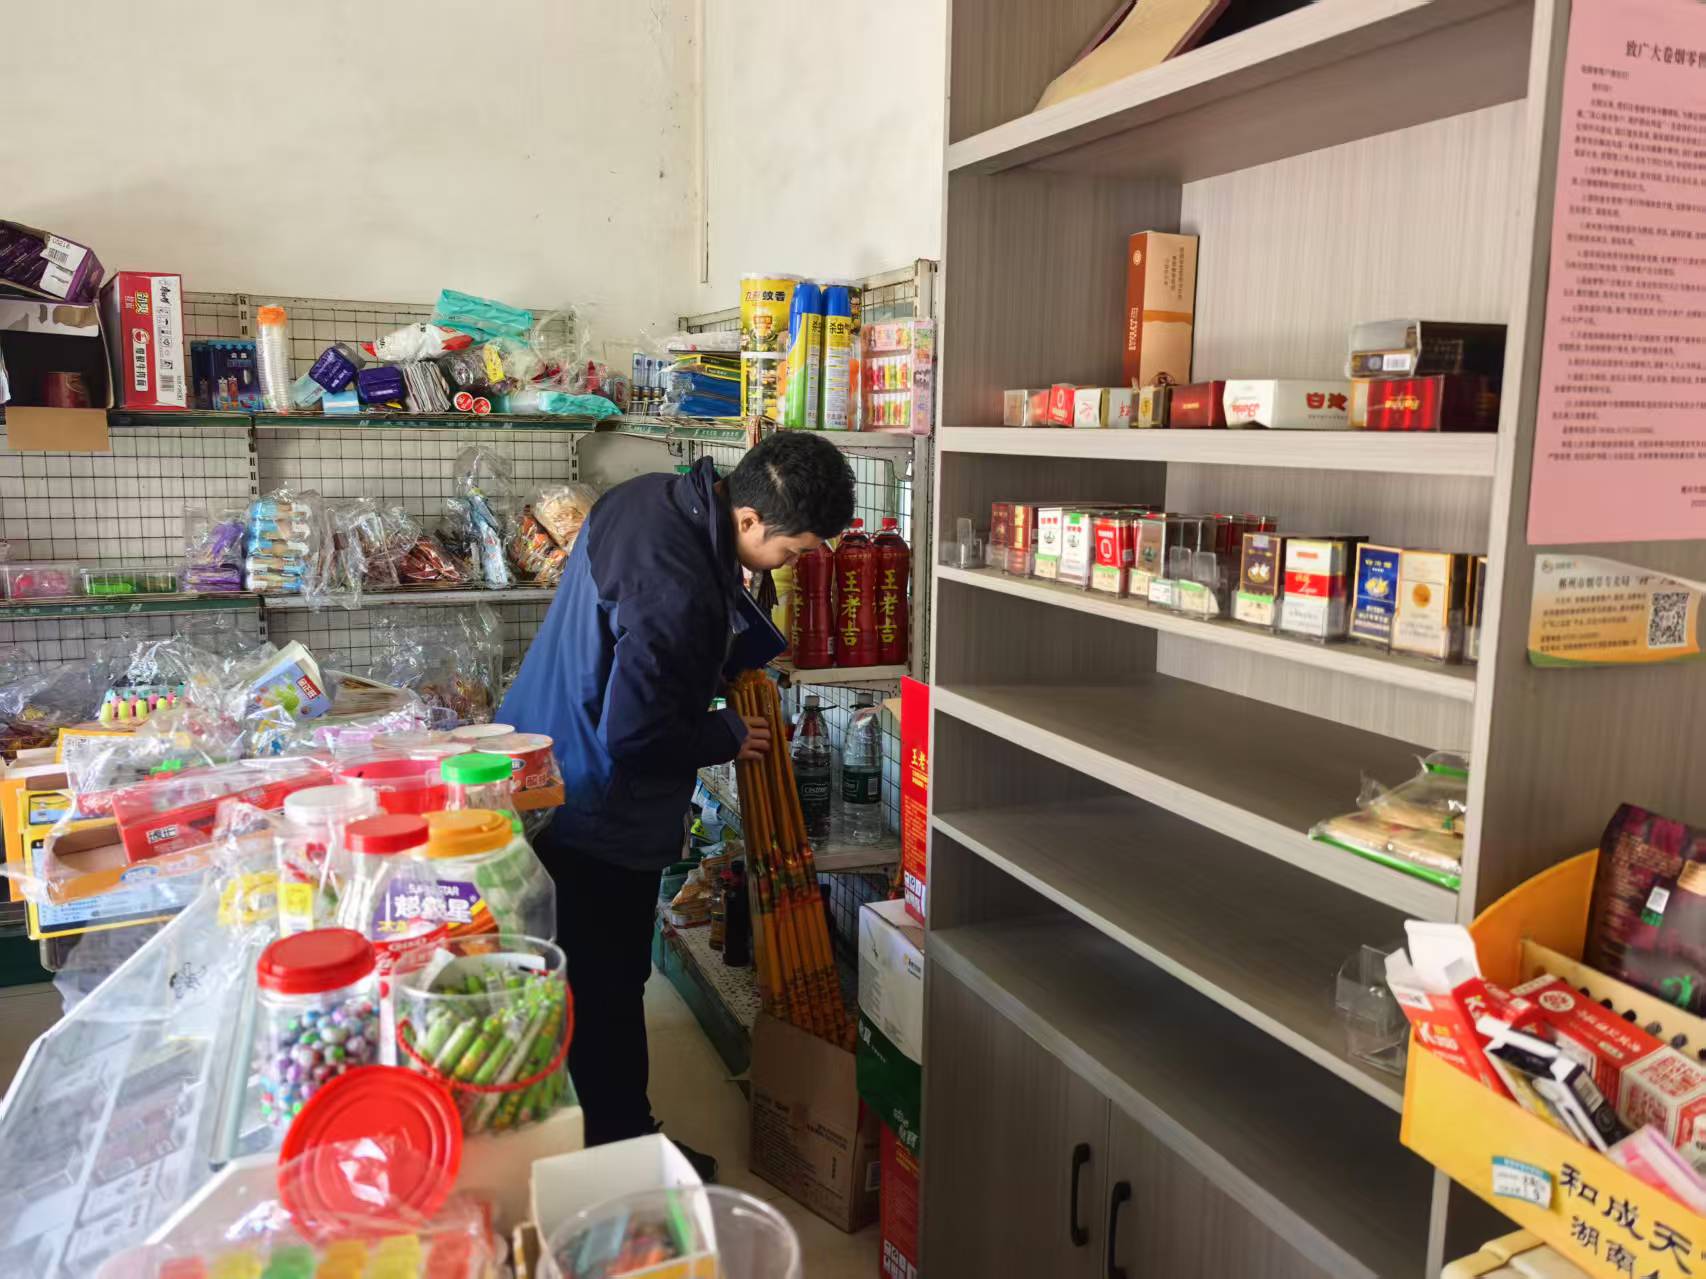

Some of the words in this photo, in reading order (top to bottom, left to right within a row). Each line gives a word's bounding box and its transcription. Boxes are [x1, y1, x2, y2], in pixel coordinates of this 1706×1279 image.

[841, 570, 861, 646] 王老吉
[879, 569, 898, 643] 王老吉
[911, 748, 928, 771] 王老
